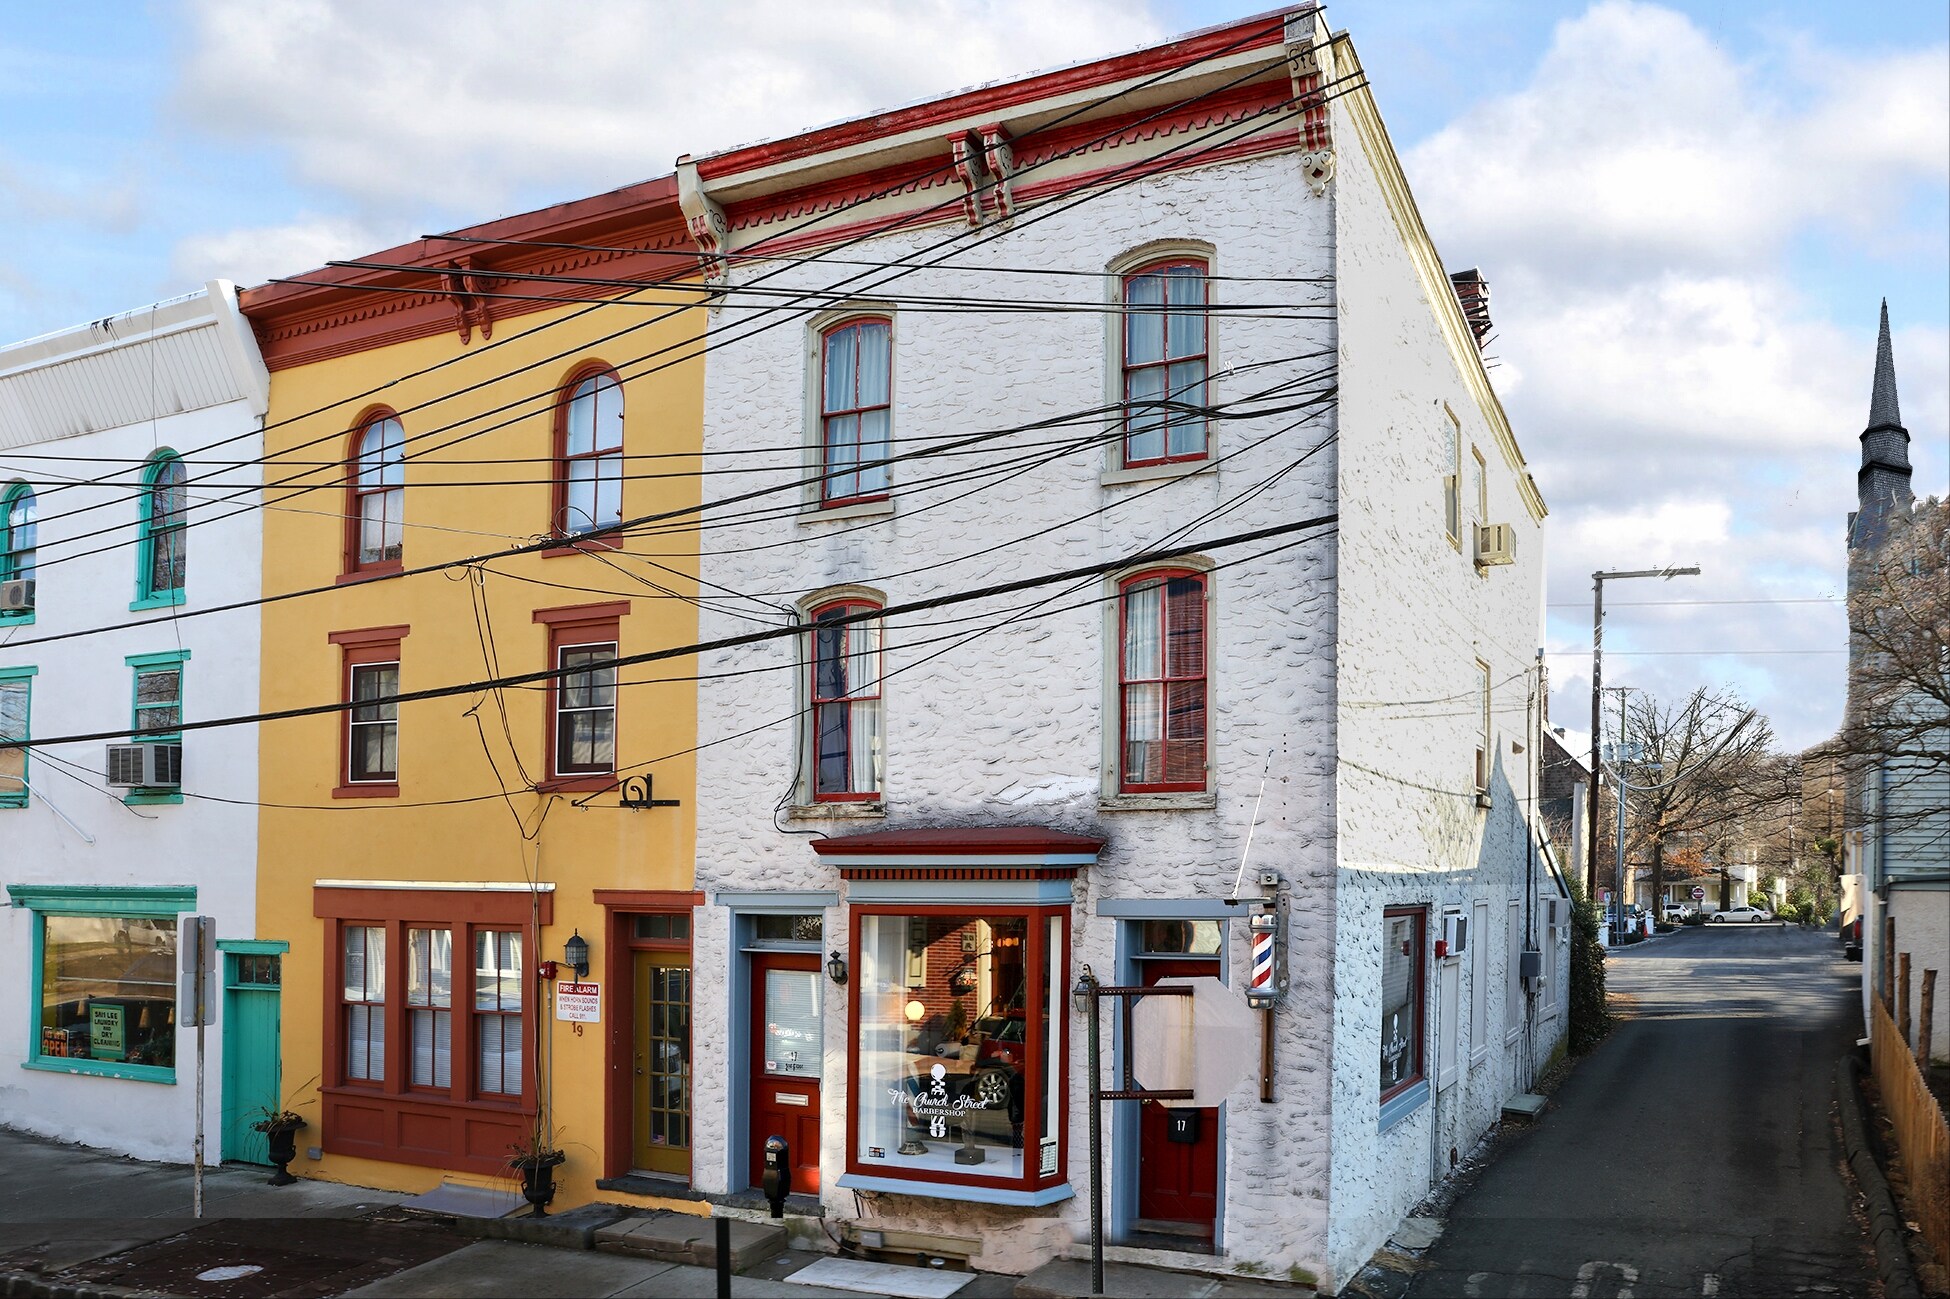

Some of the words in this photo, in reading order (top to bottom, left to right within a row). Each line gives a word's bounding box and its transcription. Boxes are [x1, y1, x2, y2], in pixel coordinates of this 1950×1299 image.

[560, 984, 574, 992] FIRE
[582, 997, 598, 1005] SOUNDS
[107, 1012, 118, 1020] LEE
[571, 1021, 583, 1037] 19
[94, 1038, 120, 1047] CLEANING
[887, 1088, 909, 1105] The
[913, 1091, 949, 1108] Church
[952, 1094, 990, 1110] Street
[912, 1107, 966, 1117] BARBERSHOP
[1177, 1120, 1186, 1131] 17
